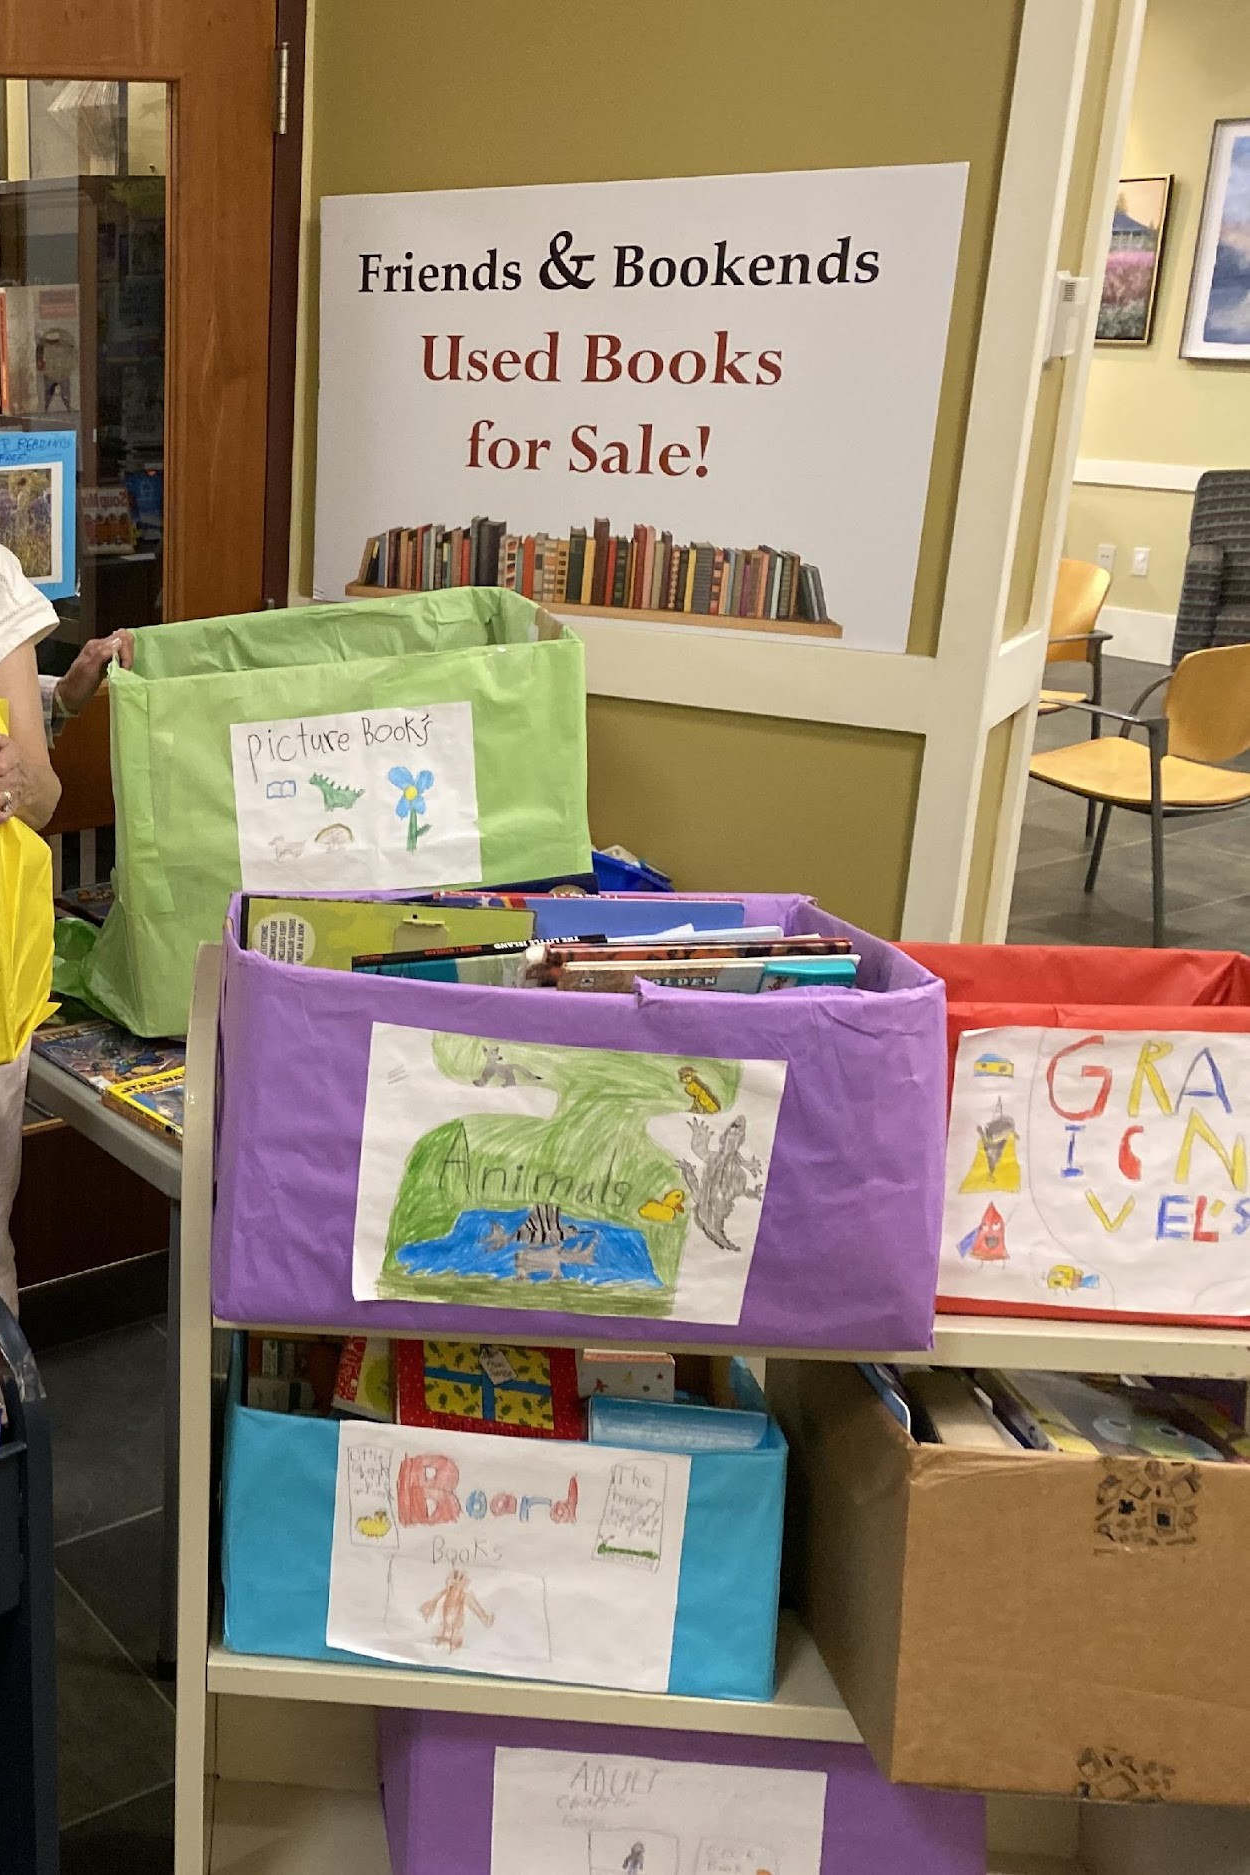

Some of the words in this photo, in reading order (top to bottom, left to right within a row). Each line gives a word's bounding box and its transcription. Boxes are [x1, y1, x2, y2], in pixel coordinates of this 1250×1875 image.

[358, 248, 522, 293] Friends
[538, 230, 596, 290] &
[613, 236, 880, 288] Bookends
[421, 331, 561, 384] Used
[581, 331, 783, 386] Books
[466, 419, 550, 471] for
[568, 424, 711, 478] Sale!
[493, 939, 529, 951] ISLAND
[527, 936, 558, 949] LITTLE
[558, 934, 581, 945] THE
[653, 975, 716, 987] OLDEN
[1046, 1035, 1233, 1121] GRA
[438, 1120, 632, 1206] Animals
[397, 1452, 578, 1528] Board
[614, 1464, 652, 1489] The
[570, 1760, 661, 1797] ADULT
